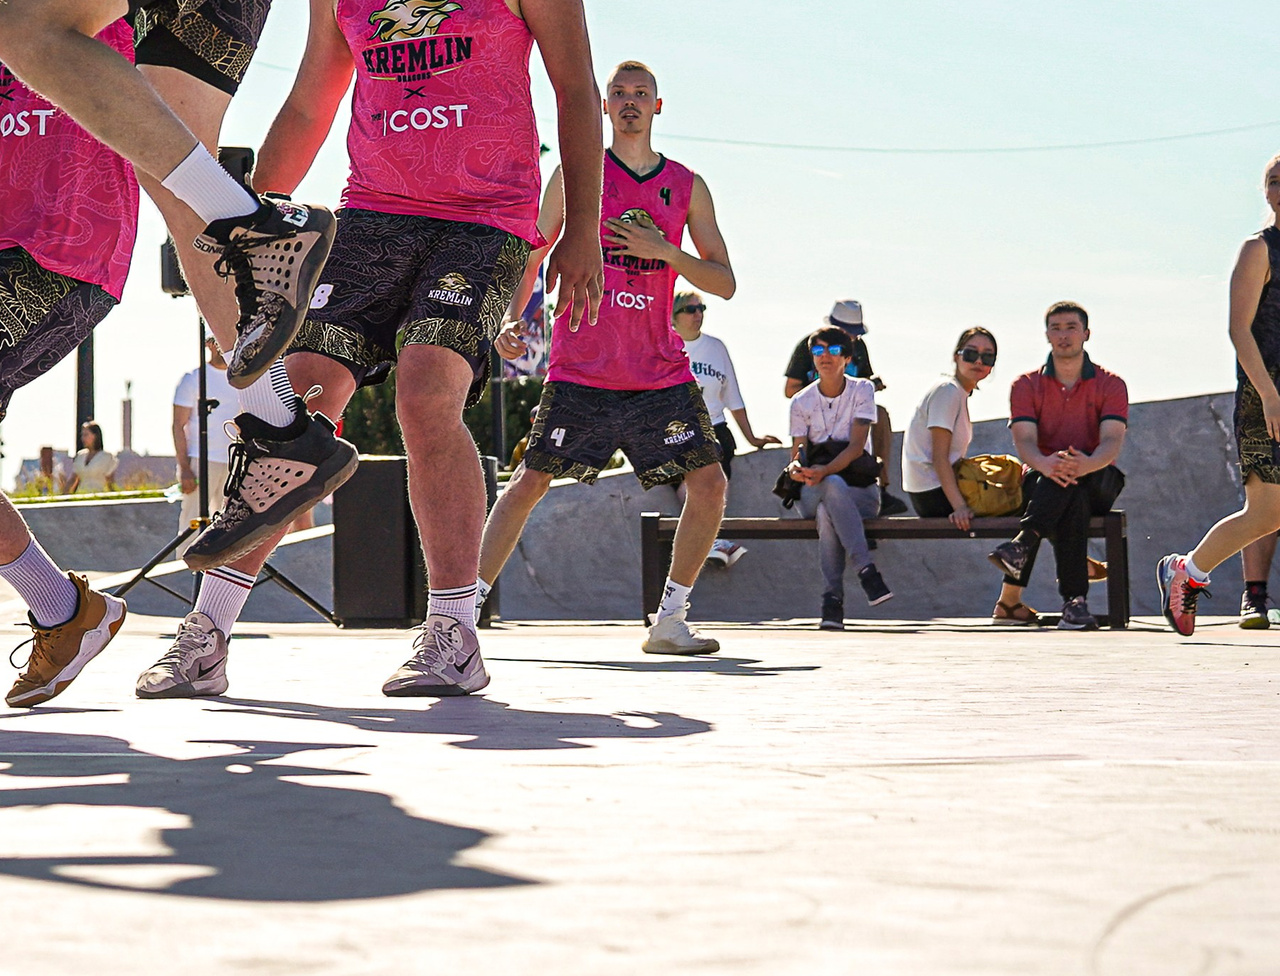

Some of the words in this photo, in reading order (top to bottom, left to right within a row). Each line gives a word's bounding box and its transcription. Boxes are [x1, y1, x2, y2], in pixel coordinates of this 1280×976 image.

[362, 37, 473, 74] KREMLIN
[389, 104, 468, 132] COST
[659, 187, 671, 206] 4
[310, 283, 334, 310] 8
[428, 289, 473, 306] KREMLIN
[616, 291, 654, 311] COST
[691, 360, 727, 384] Vibes
[550, 428, 566, 447] 4
[663, 430, 695, 445] KREMLIN
